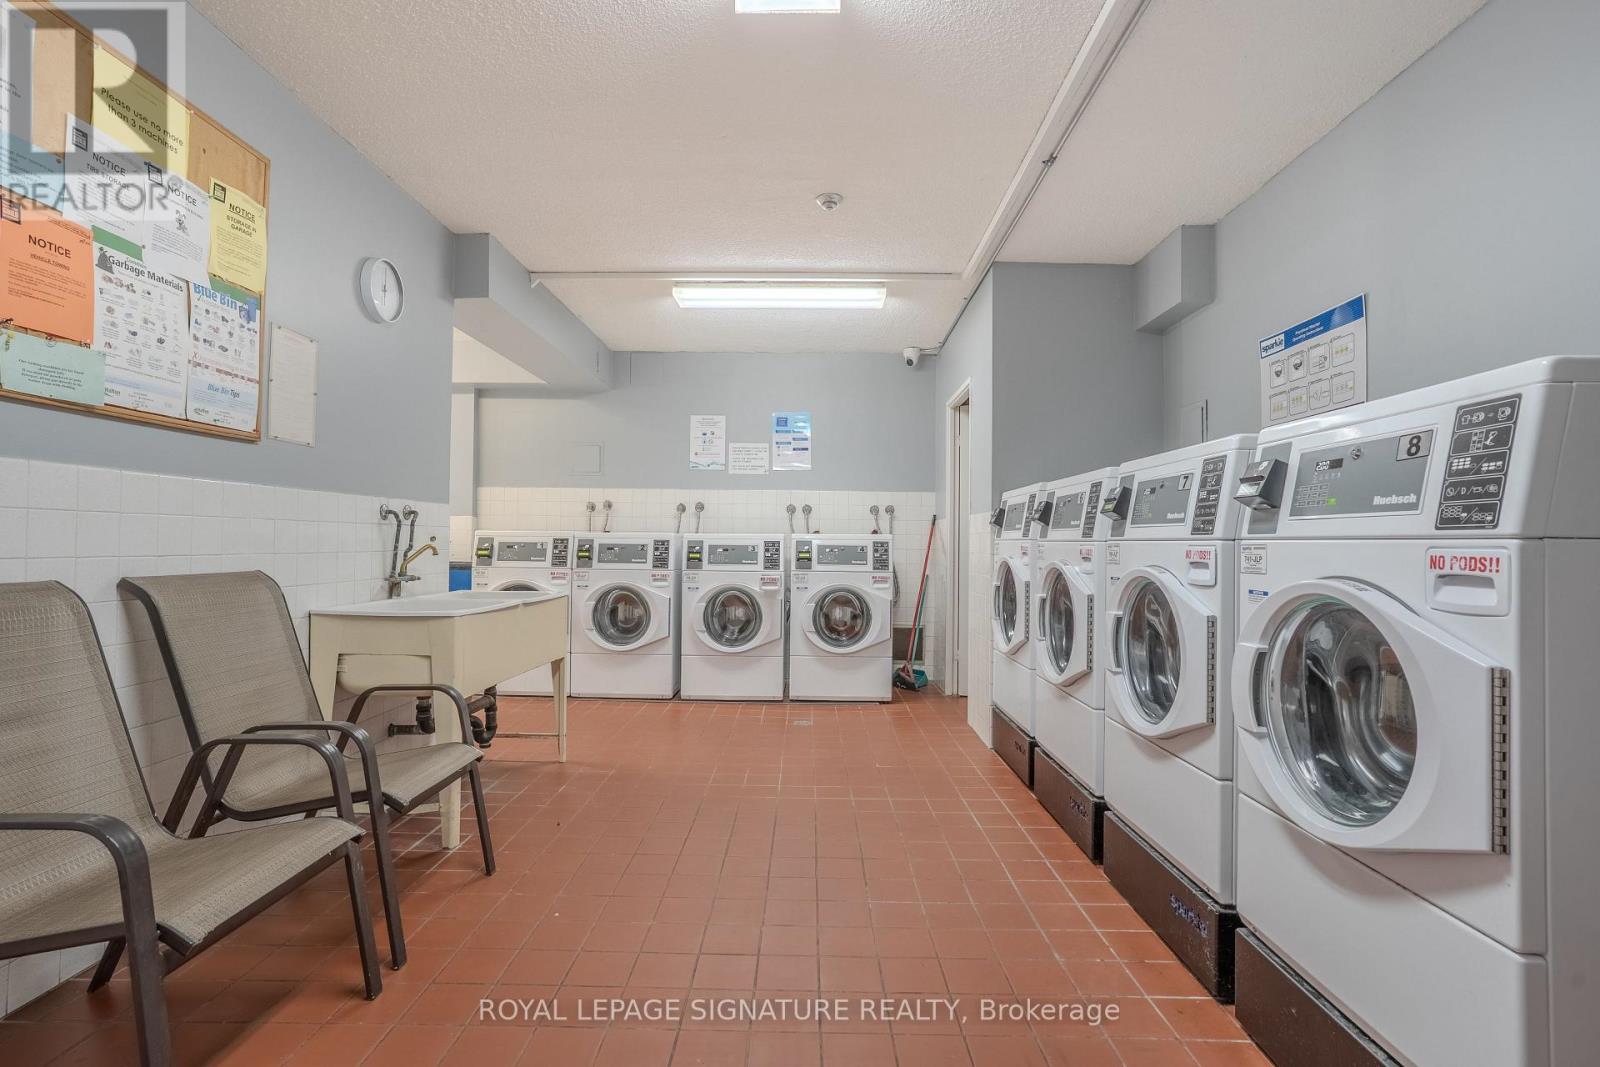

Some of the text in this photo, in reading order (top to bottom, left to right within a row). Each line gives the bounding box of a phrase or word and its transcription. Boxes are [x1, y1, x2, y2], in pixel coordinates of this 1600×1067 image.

[101, 88, 184, 147] Please use no more
[108, 104, 179, 154] than 3 machines
[92, 152, 127, 176] NOTICE
[167, 184, 198, 207] NOTICE
[226, 215, 252, 231] STORAGE
[228, 202, 256, 221] NOTICE
[230, 223, 253, 238] GARAGE
[28, 234, 72, 259] NOTICE
[108, 255, 146, 277] Garbage
[147, 270, 184, 292] Materials
[193, 282, 238, 310] Blue Bin
[207, 383, 220, 393] Blue
[230, 389, 241, 399] Tips
[1406, 434, 1422, 457] 8
[1182, 475, 1190, 489] 7
[1373, 492, 1417, 506] Huebsch
[1429, 554, 1501, 573] NO PODS!!
